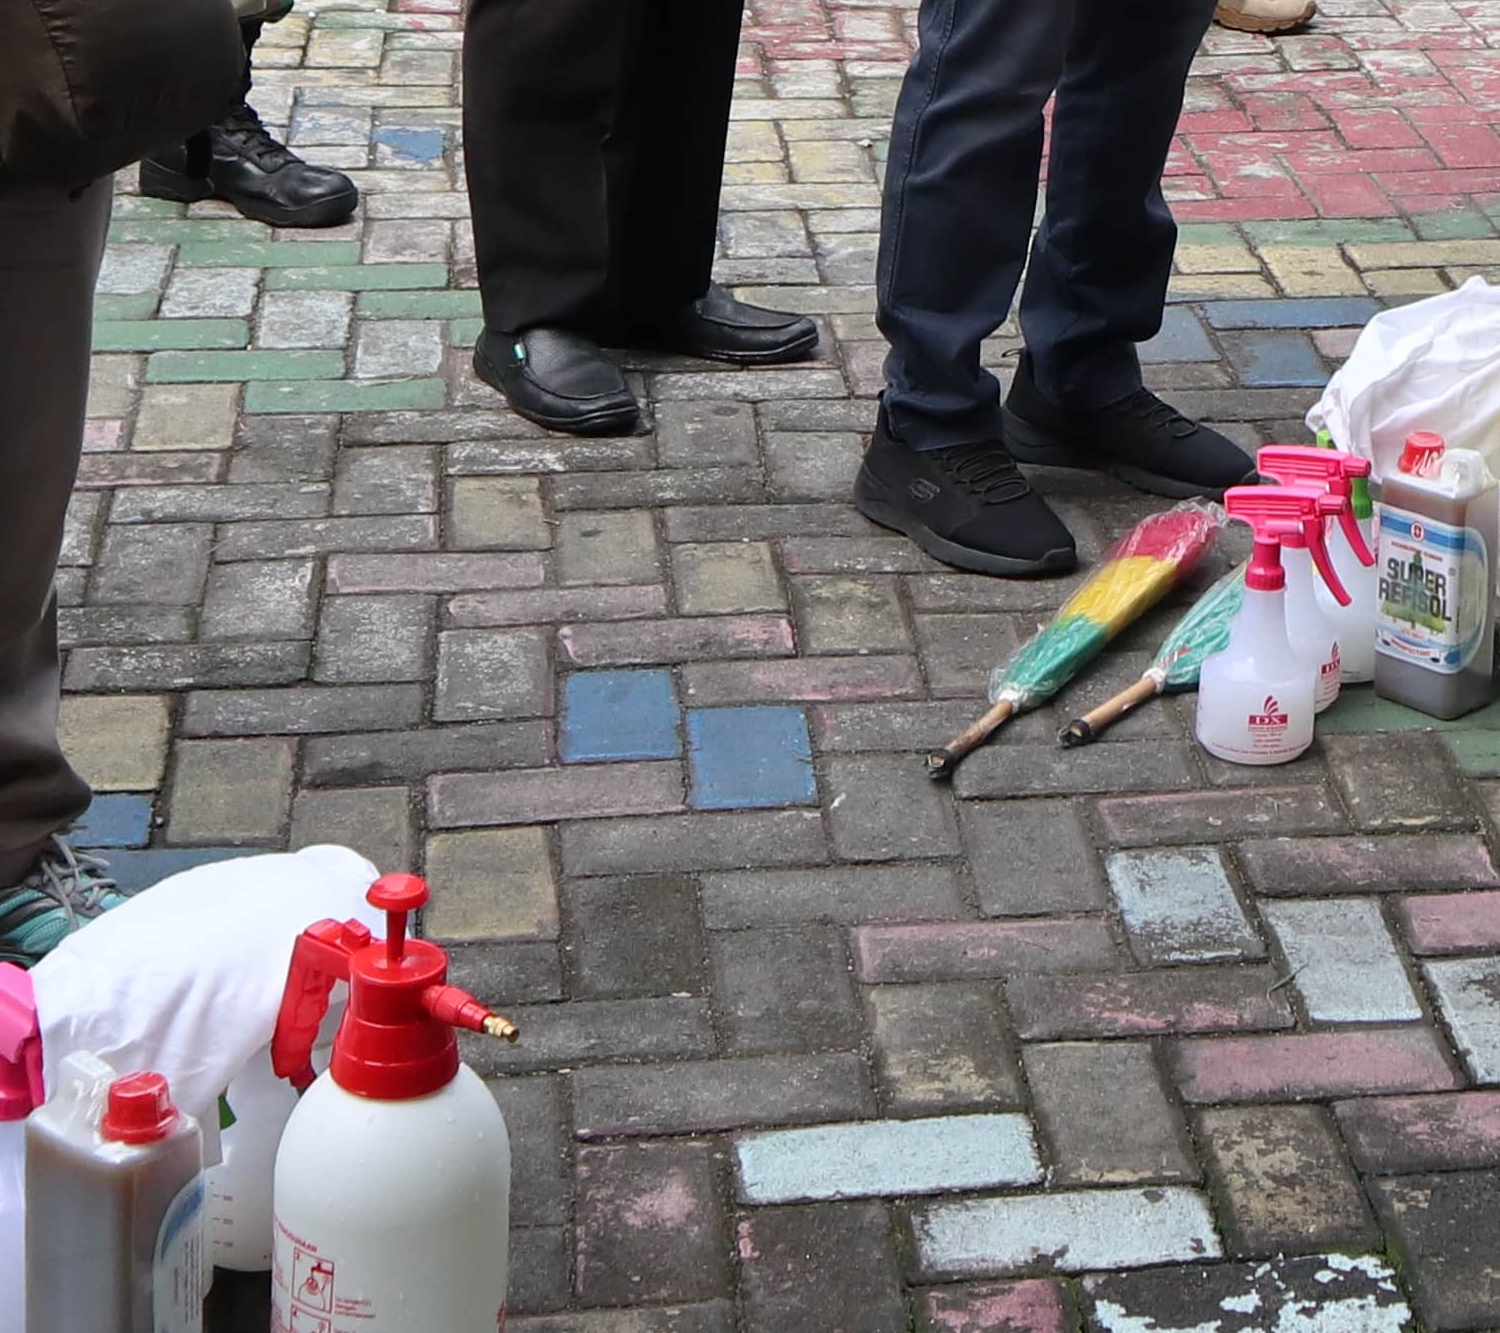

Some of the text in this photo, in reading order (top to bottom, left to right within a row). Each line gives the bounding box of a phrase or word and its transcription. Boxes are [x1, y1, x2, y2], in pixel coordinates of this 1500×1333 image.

[1386, 556, 1447, 598] SUPER
[1378, 577, 1453, 622] REFISOL
[1254, 715, 1282, 725] DX
